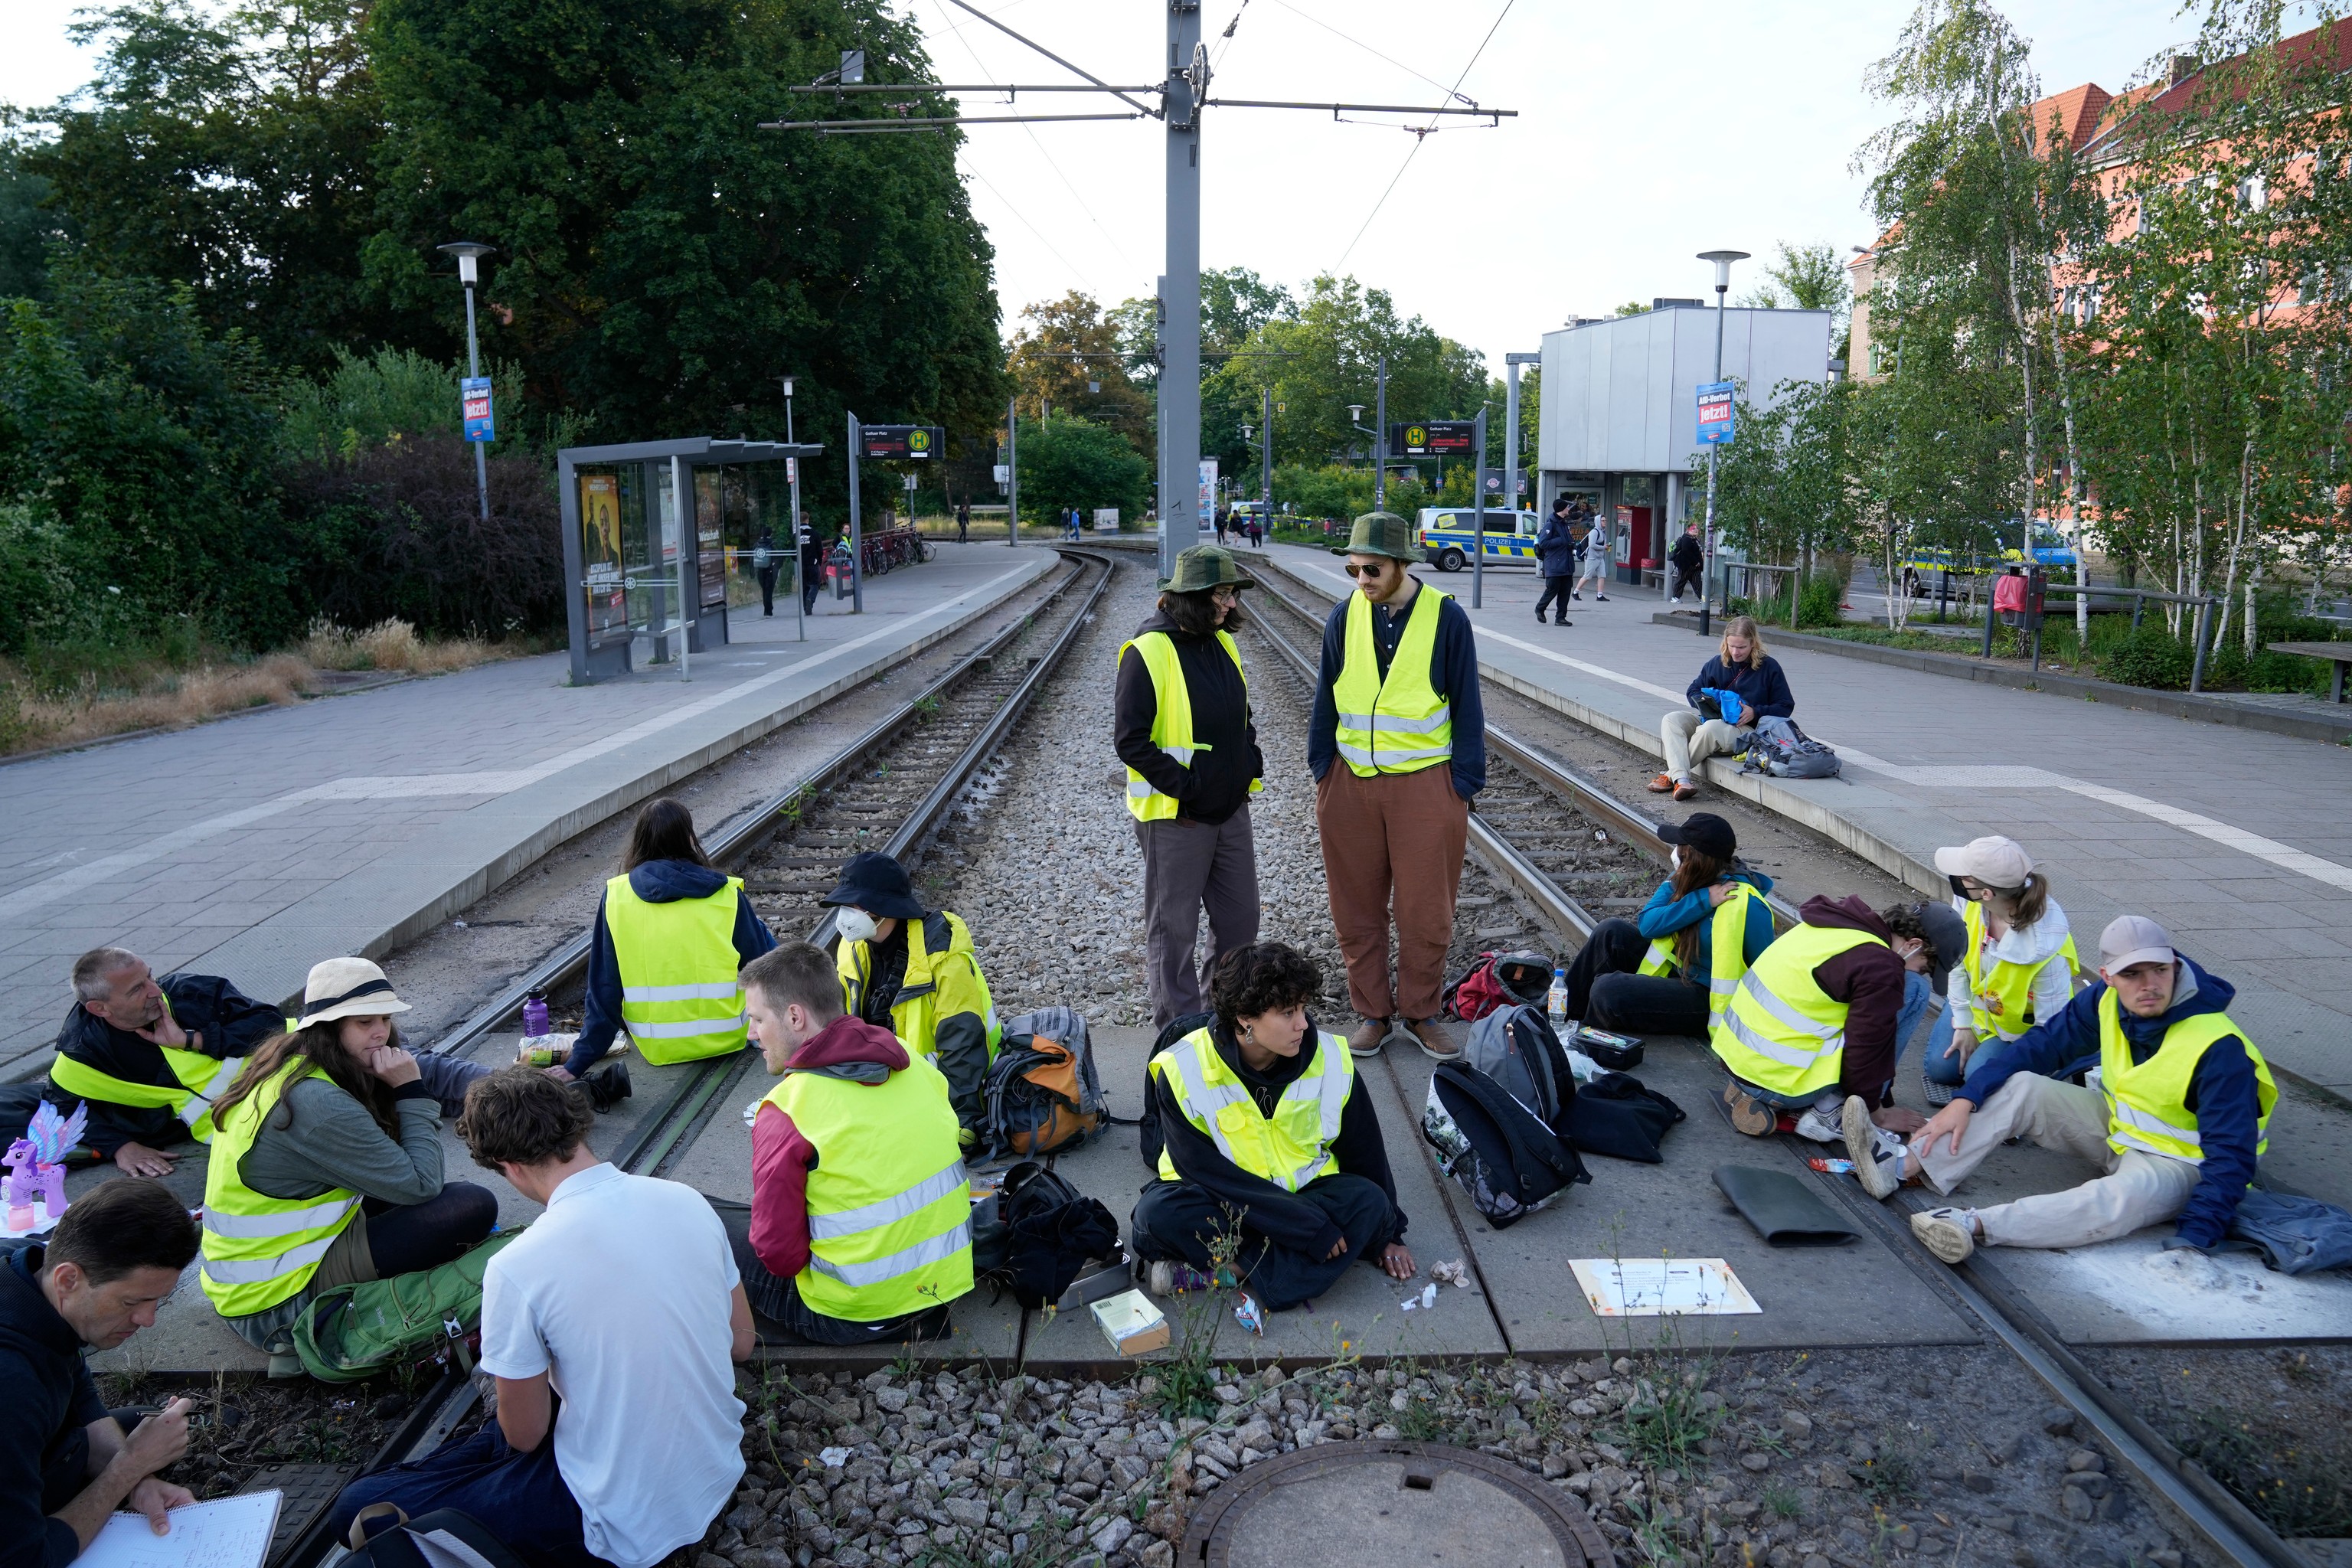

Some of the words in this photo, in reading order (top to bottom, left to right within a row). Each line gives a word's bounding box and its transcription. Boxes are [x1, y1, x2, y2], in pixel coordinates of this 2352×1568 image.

[1699, 393, 1730, 405] AfD-Verbot
[466, 401, 488, 420] jetzt!
[1700, 405, 1728, 423] jetzt!
[914, 435, 923, 446] H
[1411, 431, 1420, 442] H
